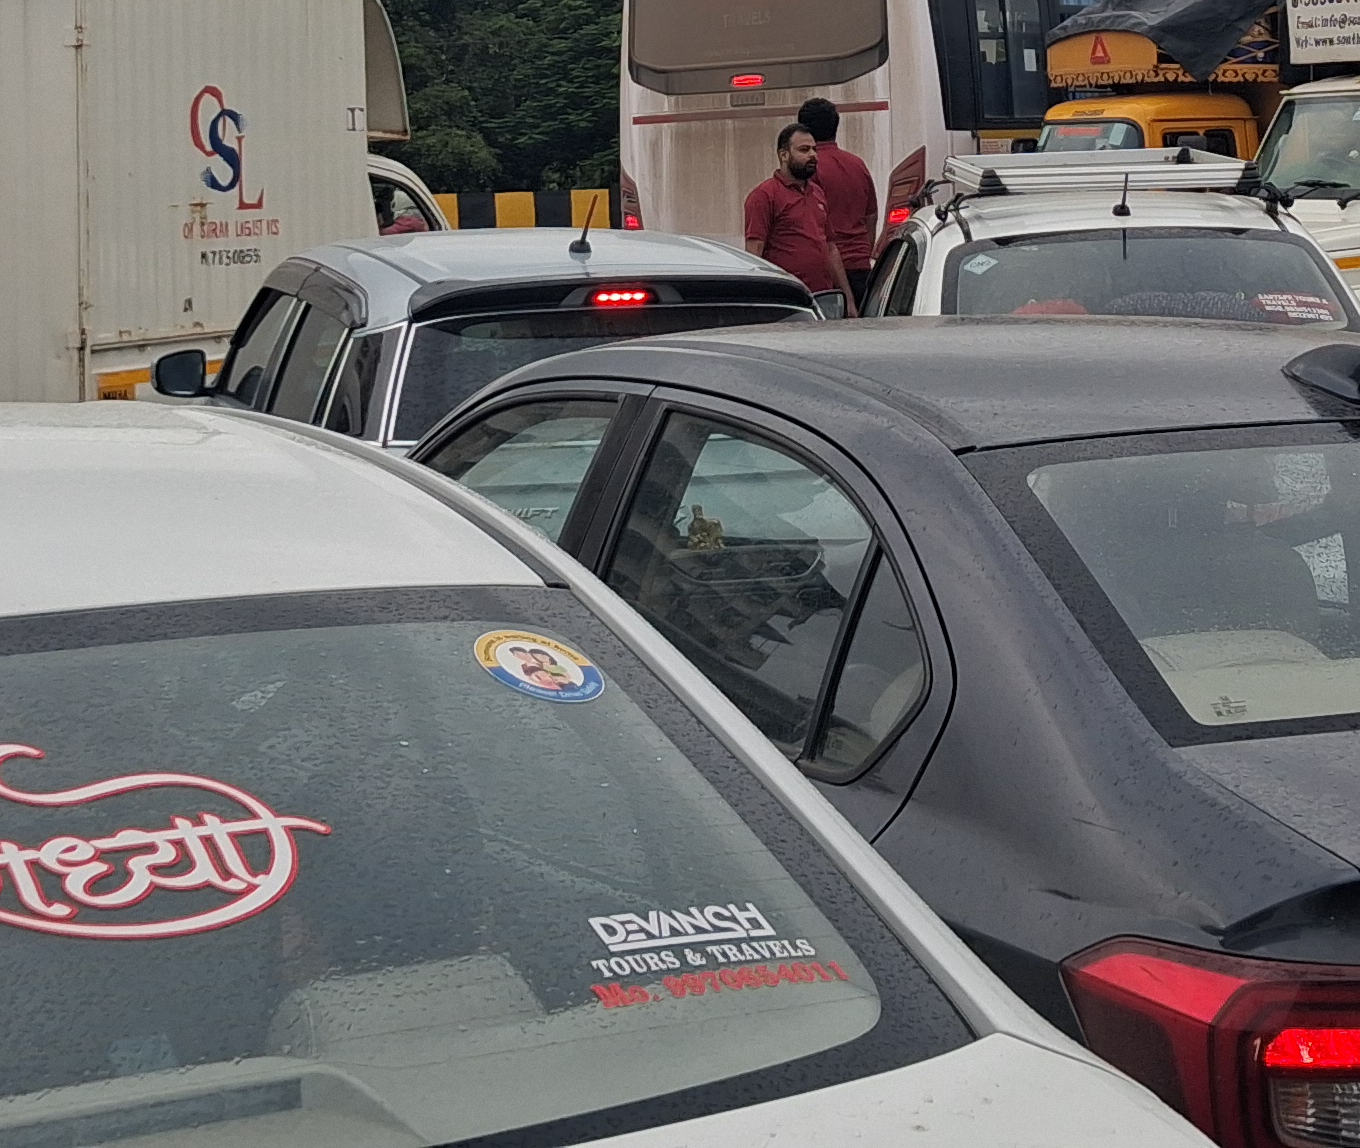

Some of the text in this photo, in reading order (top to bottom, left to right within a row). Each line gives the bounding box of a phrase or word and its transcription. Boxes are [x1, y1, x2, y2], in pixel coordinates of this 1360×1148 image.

[591, 938, 817, 978] TOURS & TRAVELS
